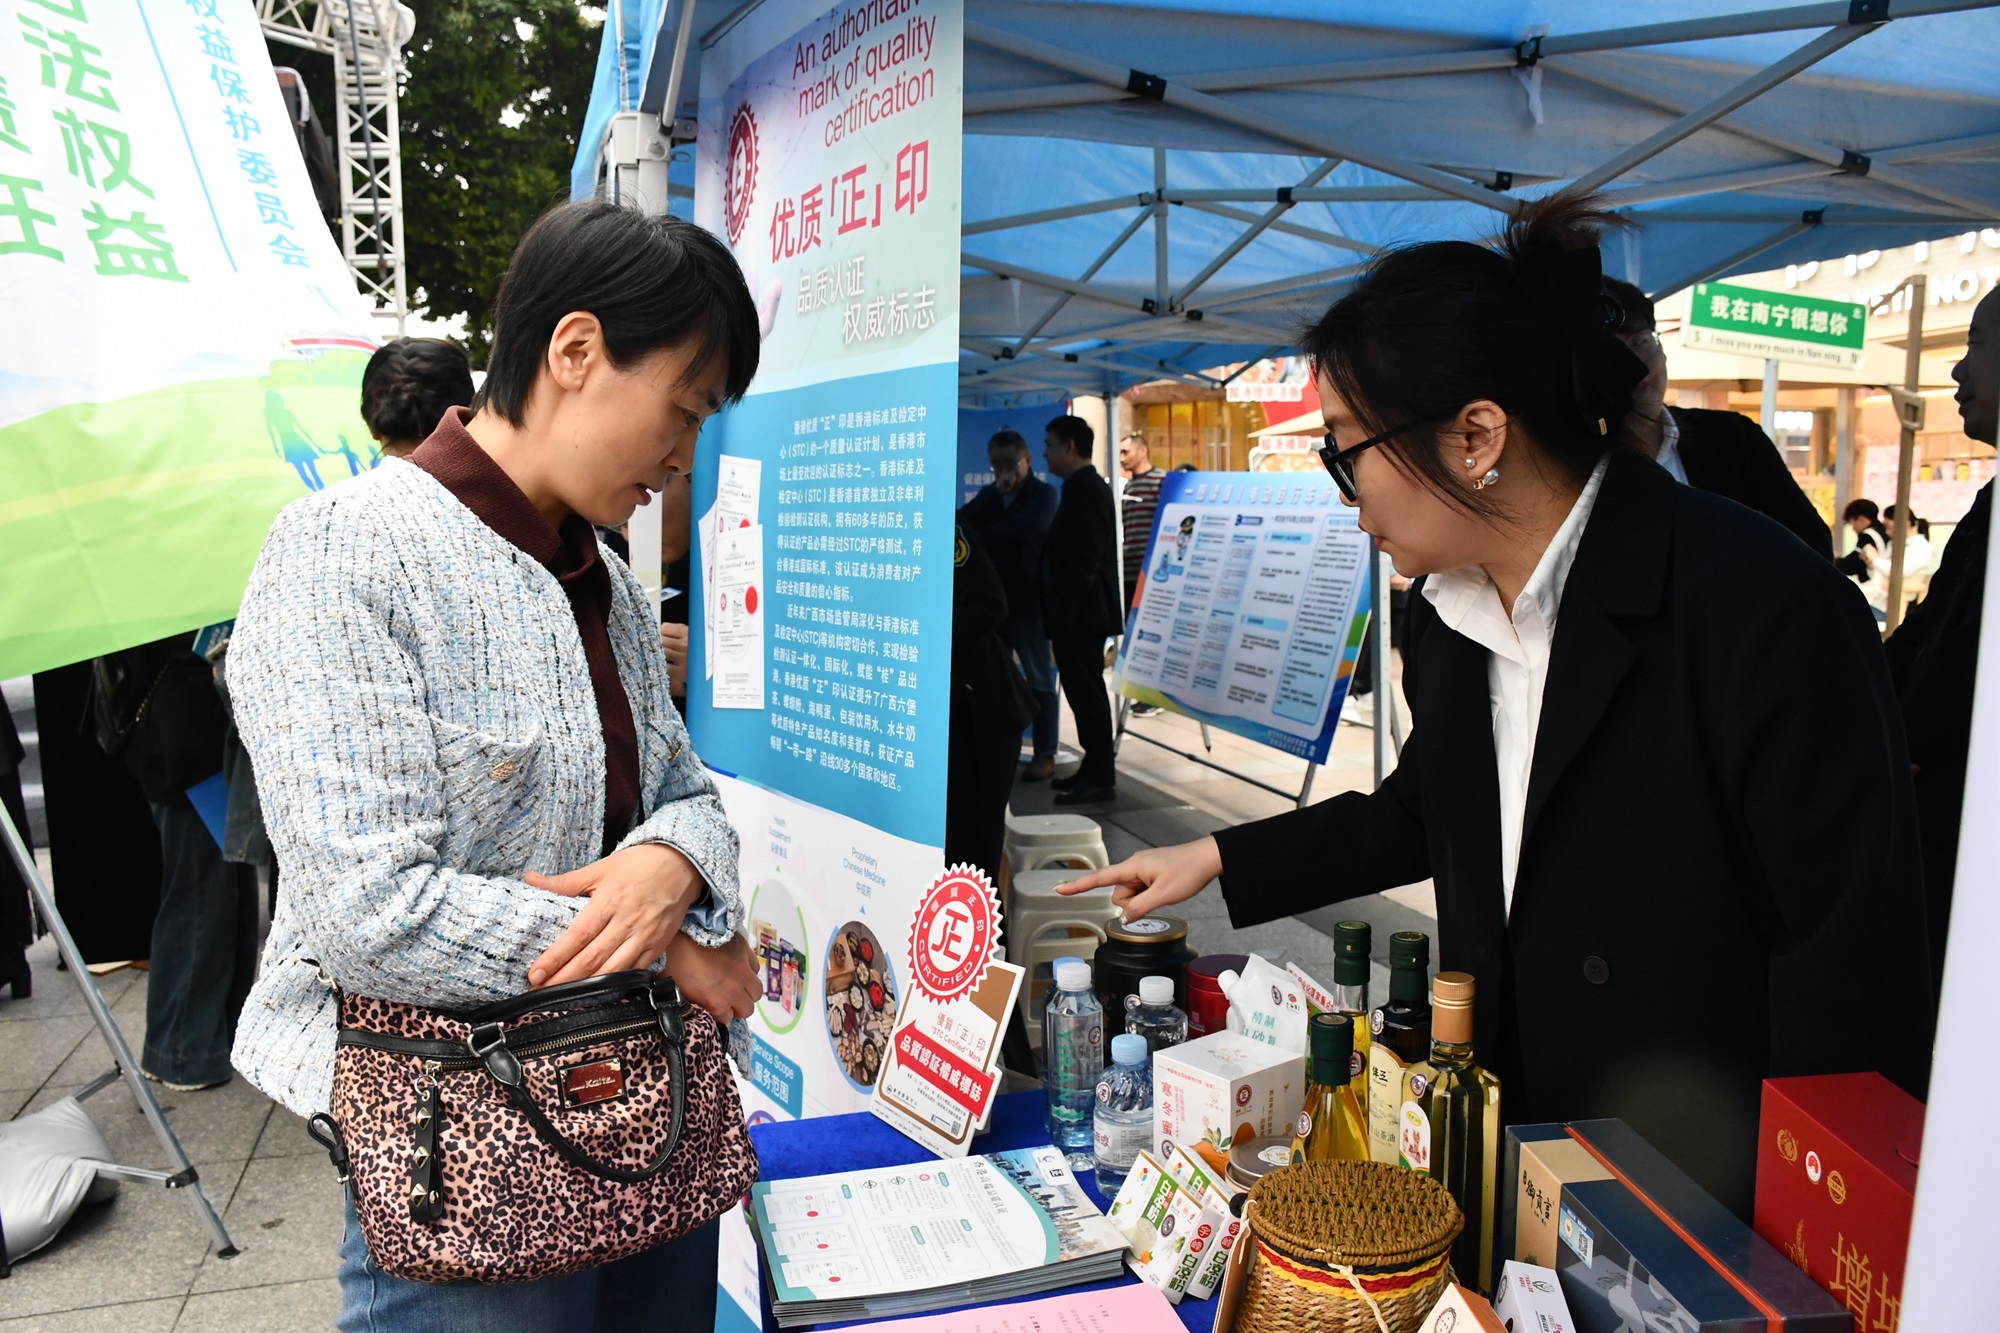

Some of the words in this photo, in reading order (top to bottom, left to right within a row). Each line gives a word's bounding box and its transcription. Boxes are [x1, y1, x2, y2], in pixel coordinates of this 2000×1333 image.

[793, 42, 816, 80] An
[799, 64, 840, 118] mark
[844, 45, 861, 91] of
[866, 15, 936, 85] quality
[825, 67, 934, 148] certification
[797, 256, 866, 315] 品质认证
[842, 284, 936, 345] 权威标志
[1710, 294, 1849, 337] 我在南宁很想你
[1715, 336, 1735, 347] miss
[1736, 339, 1751, 350] you
[1753, 341, 1771, 353] very
[1774, 343, 1796, 355] much
[1797, 345, 1804, 356] in
[1824, 350, 1841, 363] ning
[842, 857, 863, 876] Chinese
[863, 866, 886, 887] Medicine
[851, 846, 879, 870] Proprietary
[918, 939, 973, 987] CERTIFIED
[773, 1054, 795, 1080] Scope
[967, 1050, 982, 1063] Mark
[754, 1060, 789, 1105] 服务范围
[1161, 1081, 1173, 1137] 寒冬蜜
[1168, 1253, 1199, 1293] 白凉粉
[1199, 1250, 1229, 1289] 白凉粉
